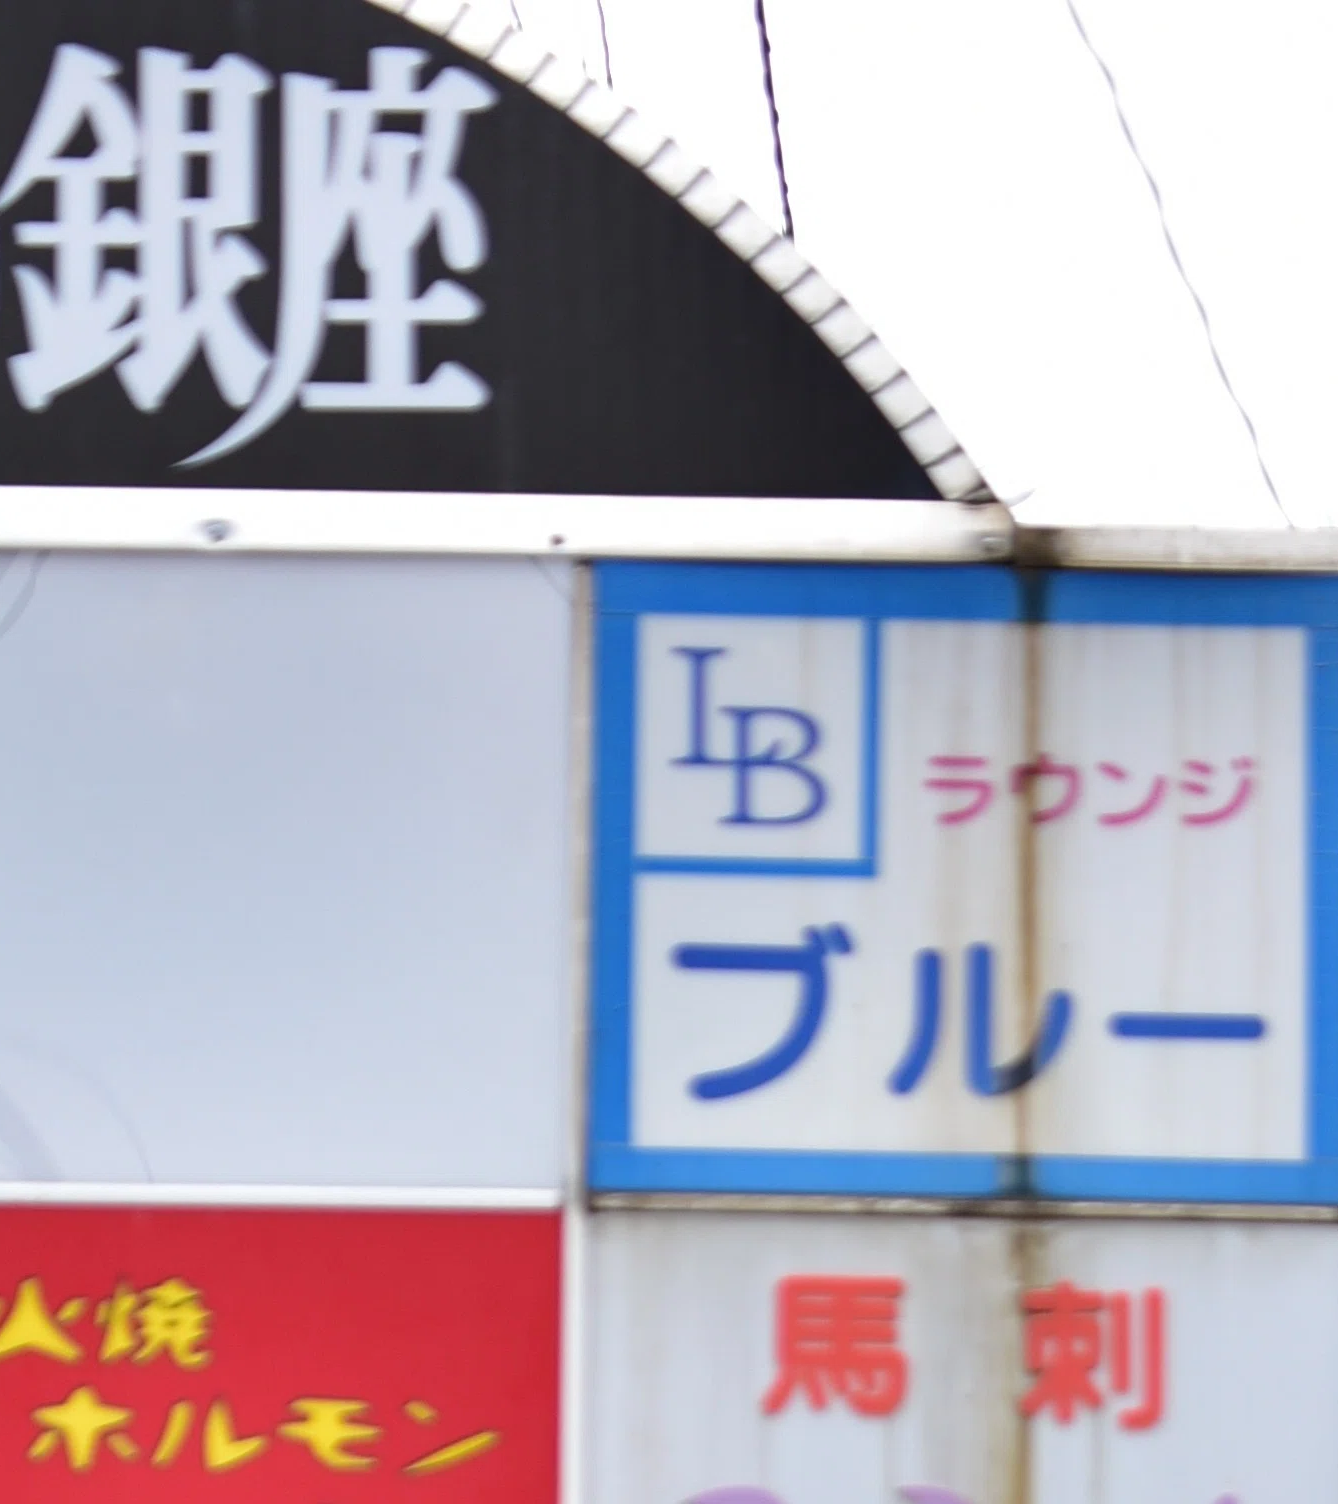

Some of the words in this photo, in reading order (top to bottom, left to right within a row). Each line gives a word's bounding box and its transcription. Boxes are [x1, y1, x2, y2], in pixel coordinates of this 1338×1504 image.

[925, 755, 1255, 828] ラウンジ
[670, 924, 1267, 1104] ブルー
[762, 1274, 1167, 1432] 馬刺
[28, 1387, 498, 1472] ホルモン
